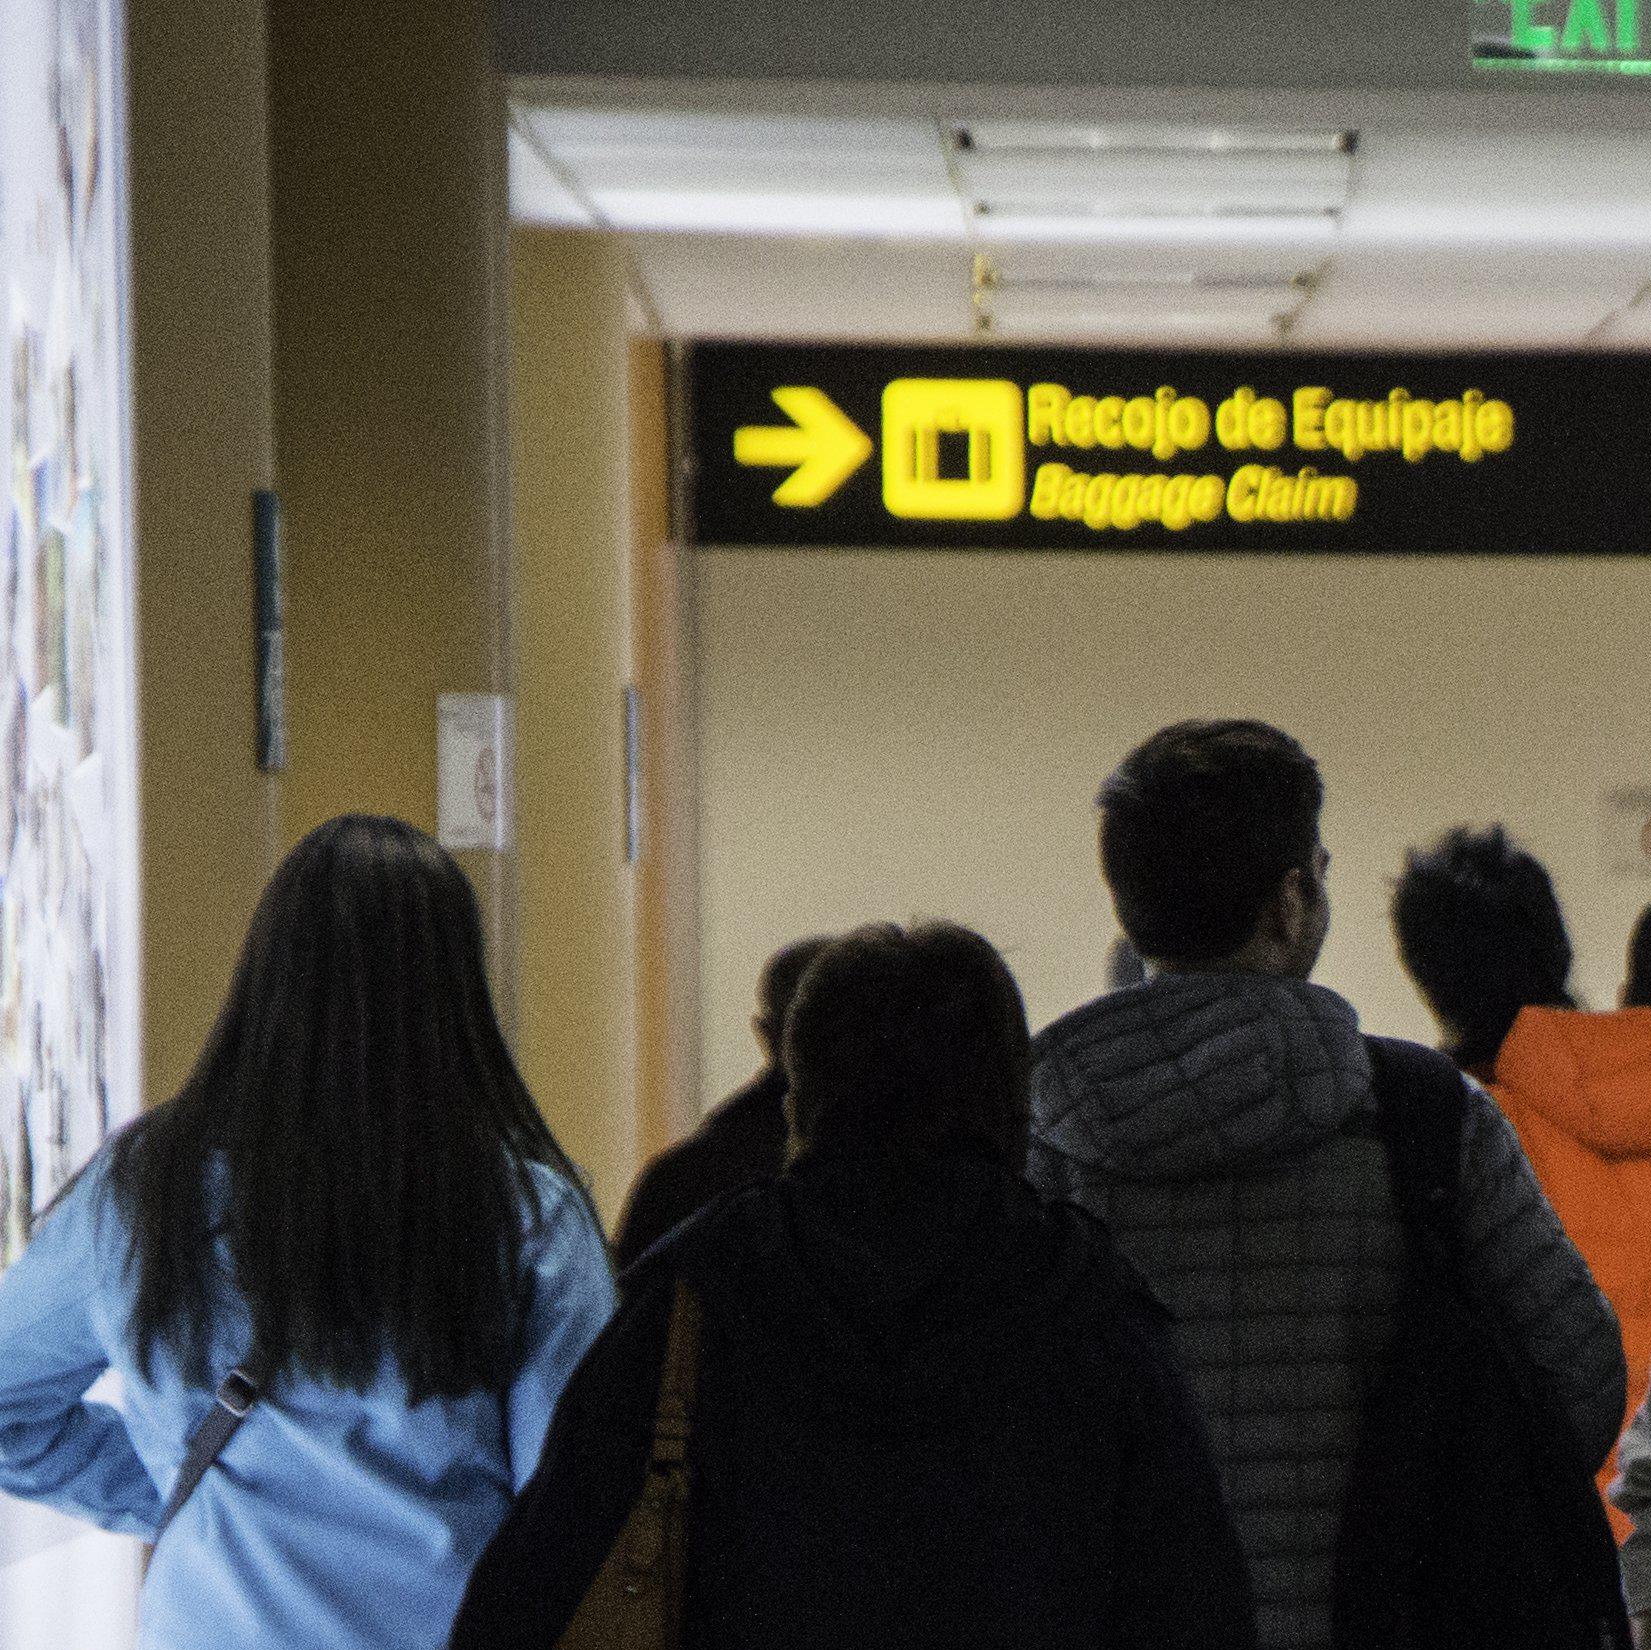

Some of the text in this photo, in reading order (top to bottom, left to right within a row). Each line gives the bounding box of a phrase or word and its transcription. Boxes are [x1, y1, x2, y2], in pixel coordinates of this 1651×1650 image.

[1028, 382, 1516, 464] Recojo de Equipaje
[1030, 462, 1359, 531] Baggage Claim
